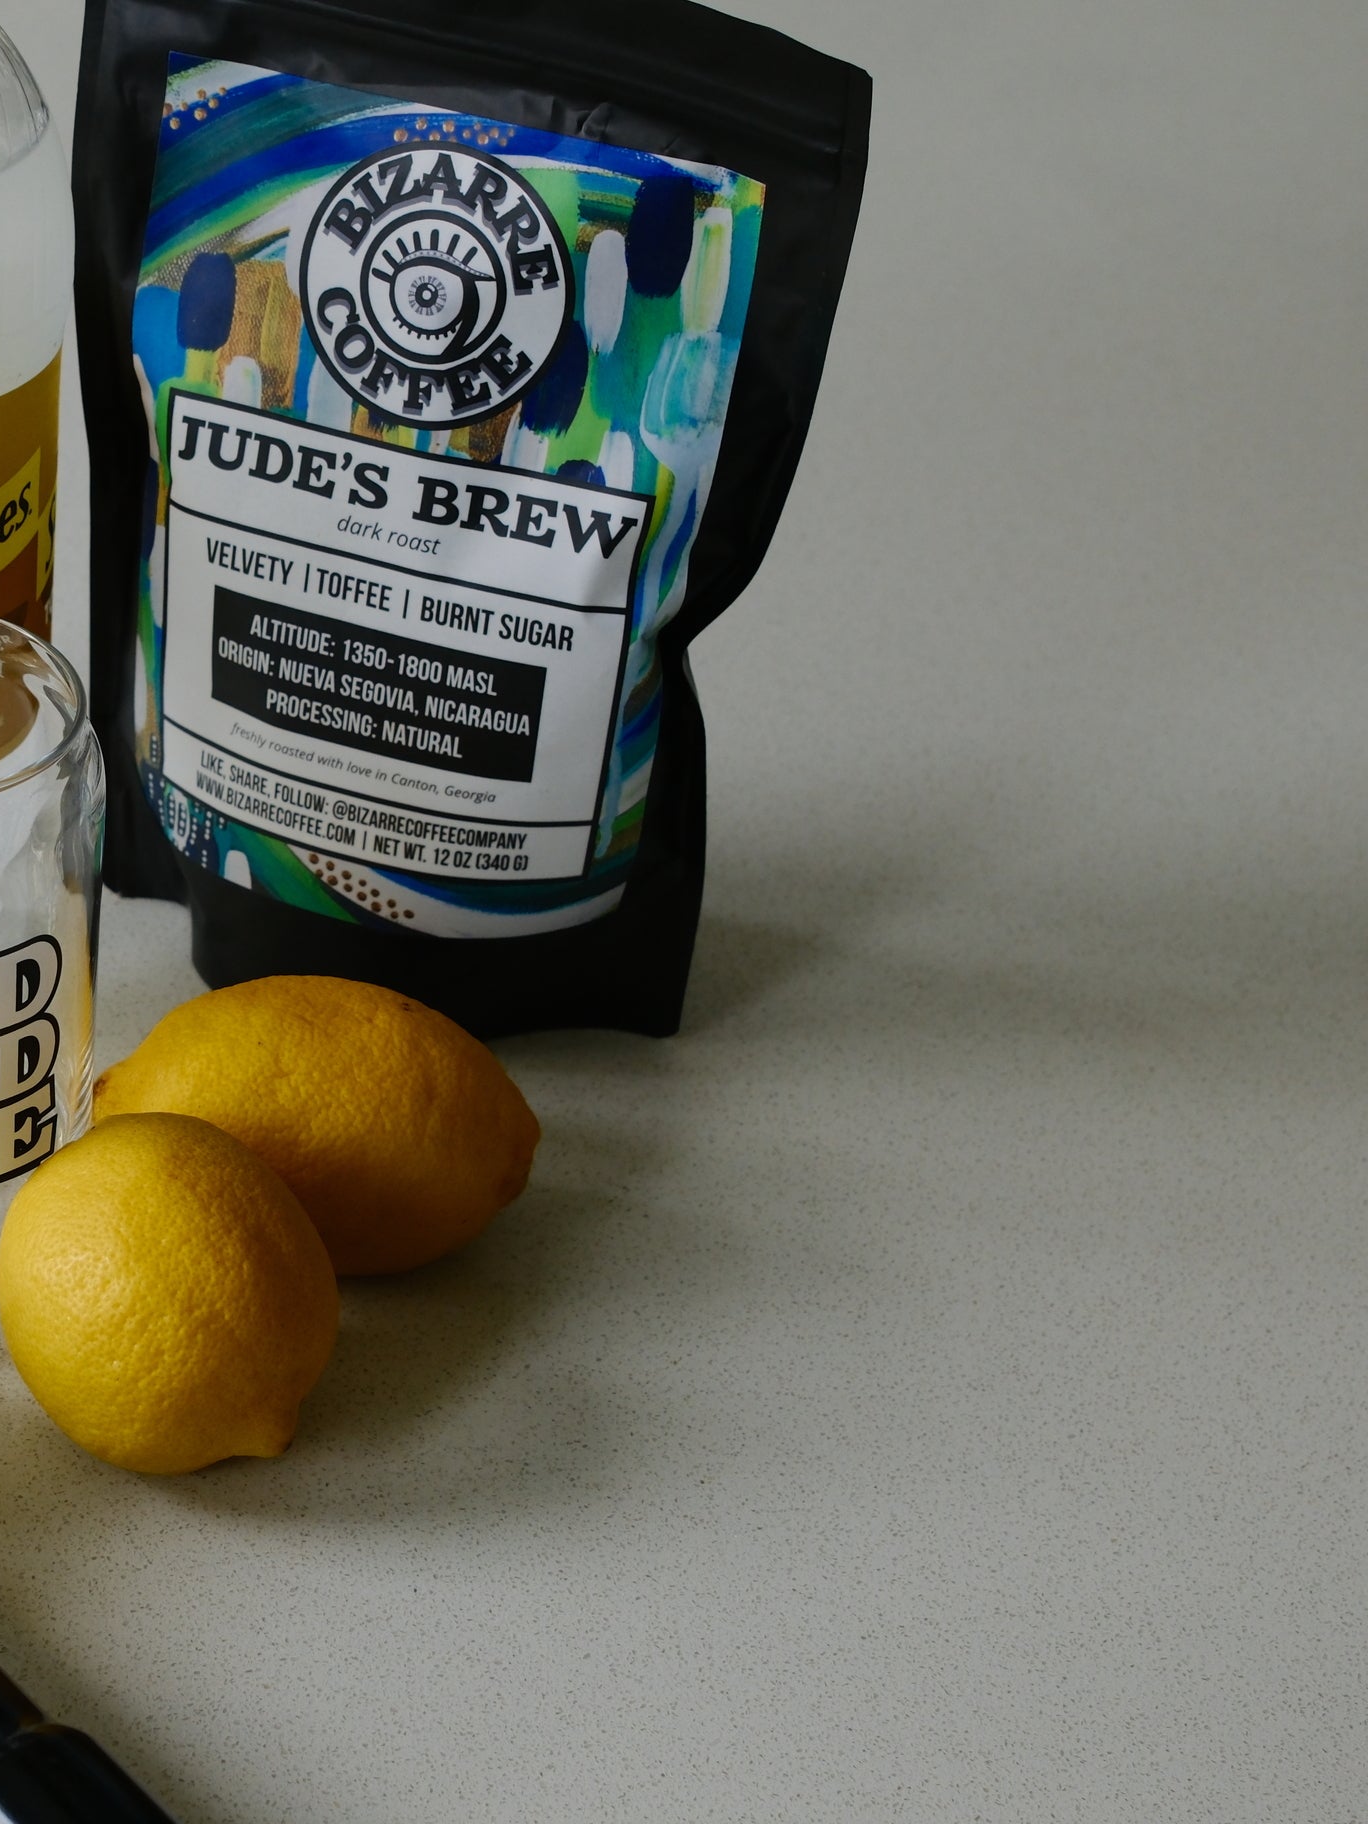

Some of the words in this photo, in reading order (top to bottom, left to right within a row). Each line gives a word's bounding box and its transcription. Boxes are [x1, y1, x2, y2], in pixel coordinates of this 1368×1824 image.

[324, 152, 560, 293] BIZARRE
[317, 286, 534, 414] COFFEE
[177, 415, 390, 510] JUDE'S
[411, 475, 639, 560] BREW
[336, 514, 383, 542] dark
[387, 530, 442, 556] roast
[206, 536, 295, 586] VELVETY
[316, 567, 393, 612] TOFFEE
[419, 595, 495, 636] BURNT
[498, 613, 574, 653] SUGAR
[217, 636, 276, 677] ORIGIN:
[278, 656, 336, 693] NUEVA
[339, 673, 420, 717] SEGOVIA,
[424, 694, 531, 737] NICARAGUA
[249, 613, 336, 658] ALTITUDE:
[343, 638, 443, 684] 1350-1800
[445, 664, 498, 697] MASL
[229, 721, 268, 749] freshly
[268, 739, 315, 762] roasted
[317, 754, 344, 771] with
[346, 761, 372, 779] love
[374, 766, 388, 782] in
[391, 772, 440, 795] Canton,
[444, 785, 497, 805] Georgia
[265, 688, 378, 739] PROCESSING:
[381, 719, 463, 759] NATURAL
[195, 770, 357, 847] WWW.BIZARRECOFFEE.COM
[373, 834, 401, 857] NET
[403, 841, 427, 863] WT.
[433, 847, 450, 867] 12
[453, 850, 473, 869] OZ
[475, 852, 511, 872] (340
[513, 854, 530, 872] G)
[200, 750, 226, 781] LIKE,
[229, 764, 271, 798] SHARE,
[274, 782, 330, 816] FOLLOW:
[332, 799, 528, 851] @BIZARRECOFFEECOMPANY
